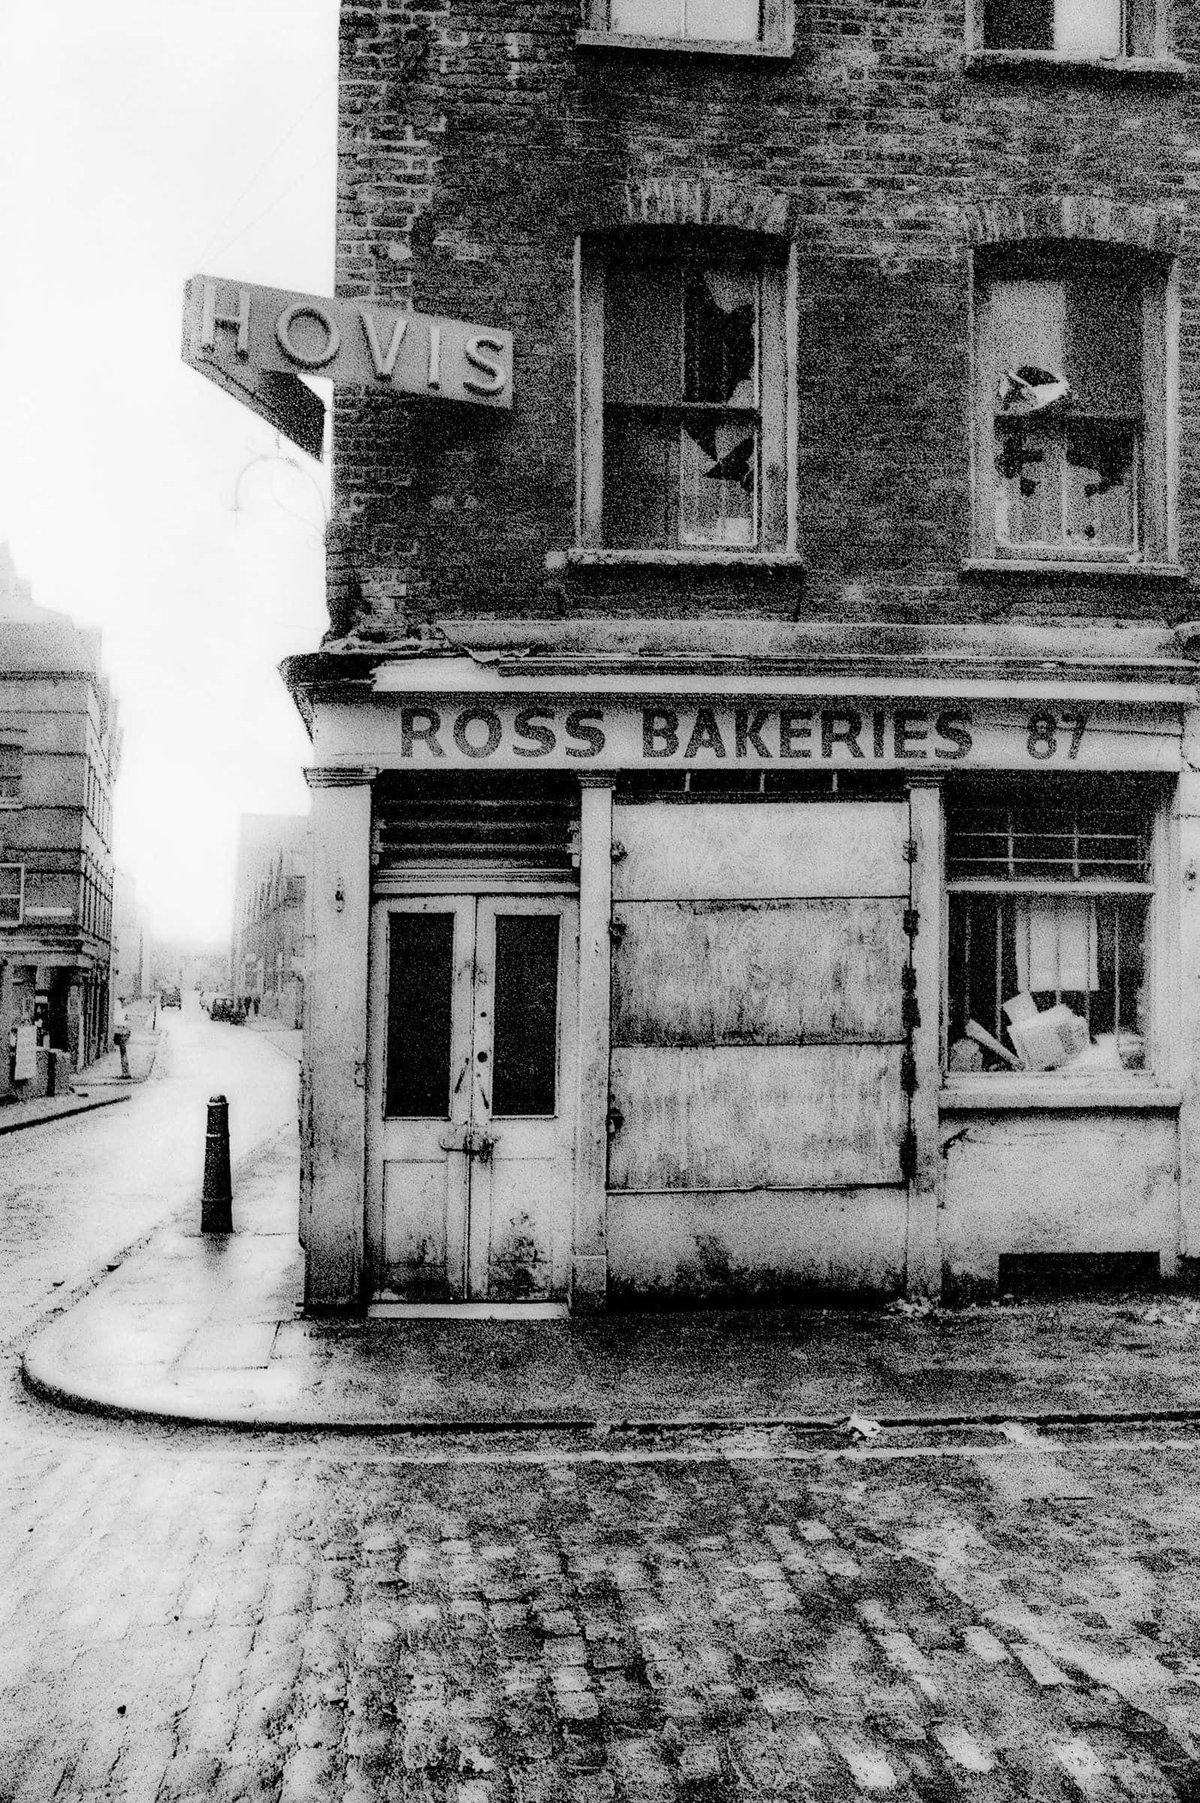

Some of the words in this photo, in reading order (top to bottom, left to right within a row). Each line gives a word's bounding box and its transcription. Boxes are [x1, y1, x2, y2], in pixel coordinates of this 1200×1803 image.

[202, 283, 507, 396] HOVIS
[401, 706, 606, 758] ROSS
[643, 706, 973, 760] BAKERIES
[1026, 711, 1088, 760] 87
